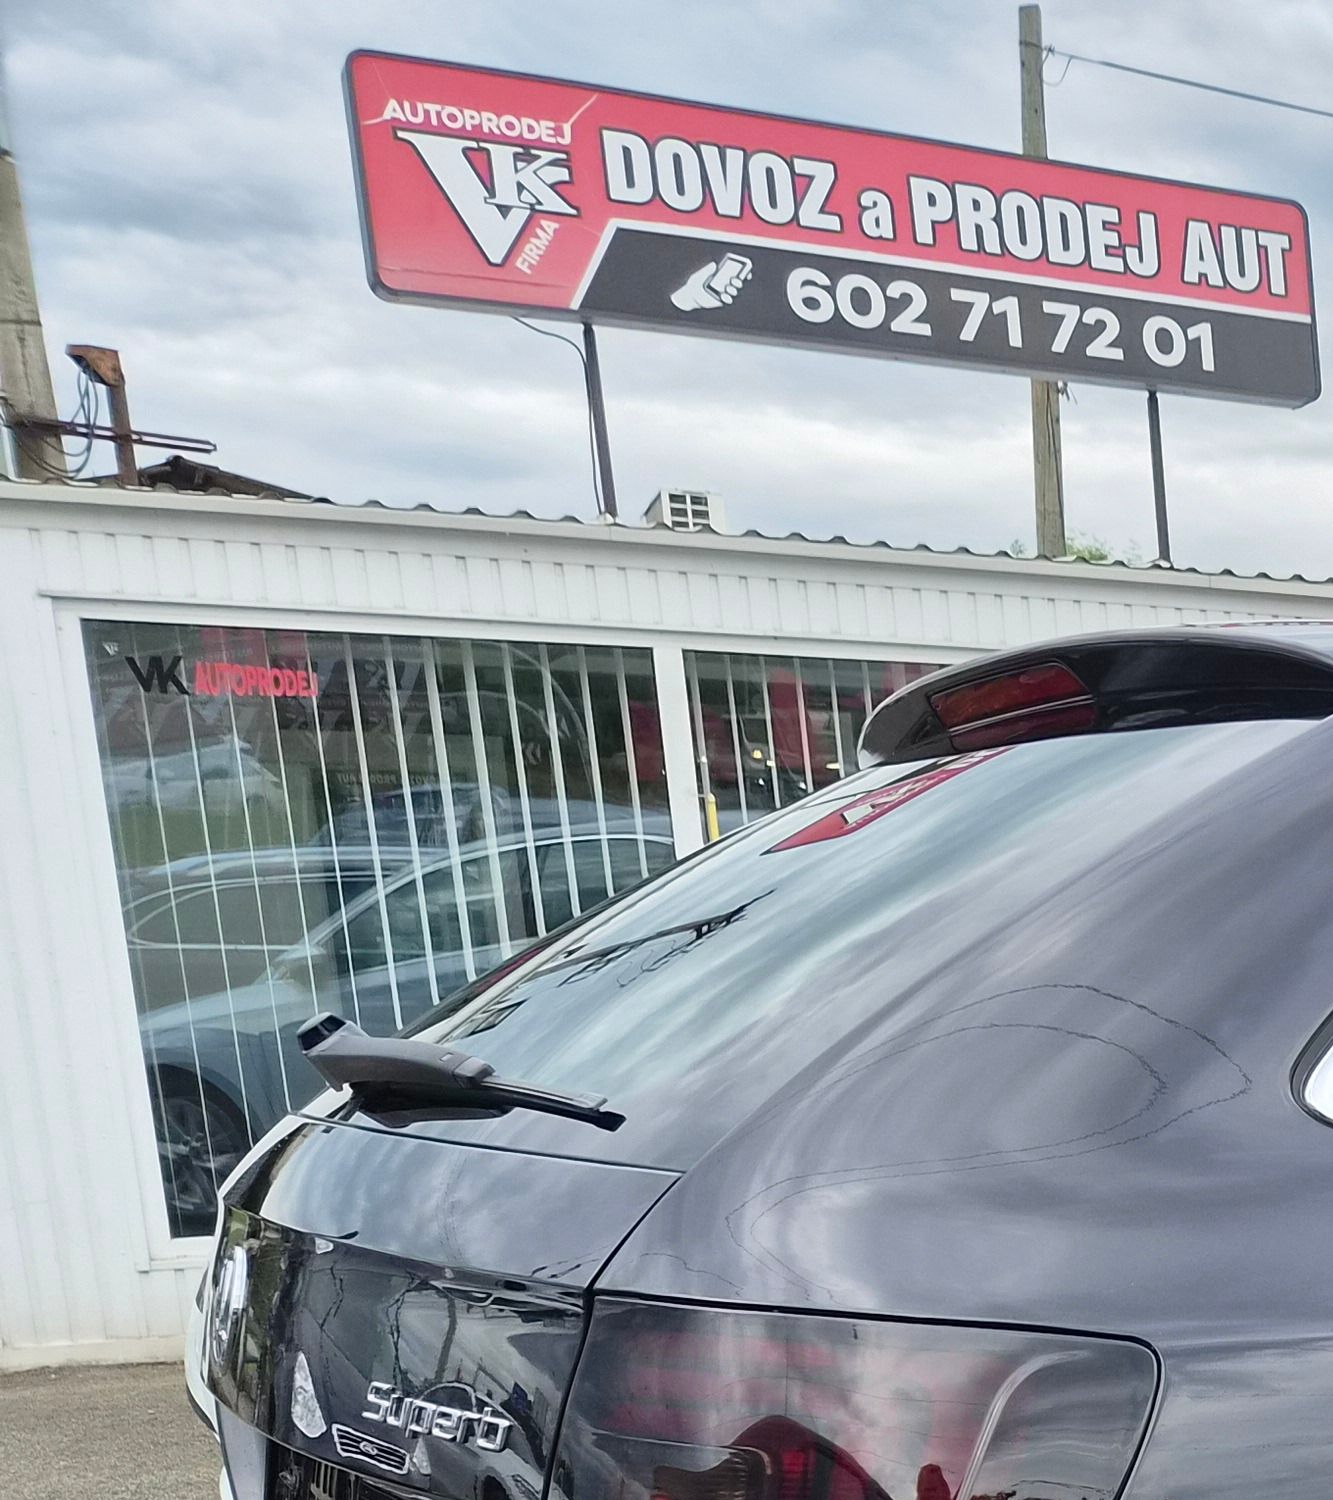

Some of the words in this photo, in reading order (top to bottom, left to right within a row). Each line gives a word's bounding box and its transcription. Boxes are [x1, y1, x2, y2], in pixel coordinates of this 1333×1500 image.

[382, 98, 573, 146] AUTOPRODEJ
[601, 128, 843, 233] DOVOZ
[858, 188, 896, 242] a
[907, 174, 1160, 278] PRODEJ
[1181, 218, 1292, 298] AUT
[515, 218, 560, 275] FIRMA
[786, 266, 933, 337] 602
[950, 286, 1024, 350] 71
[1042, 299, 1125, 362] 72
[1141, 314, 1216, 373] 01
[124, 656, 192, 696] VK
[194, 660, 319, 698] AUTOPRODEJ
[361, 1381, 513, 1452] Superb
